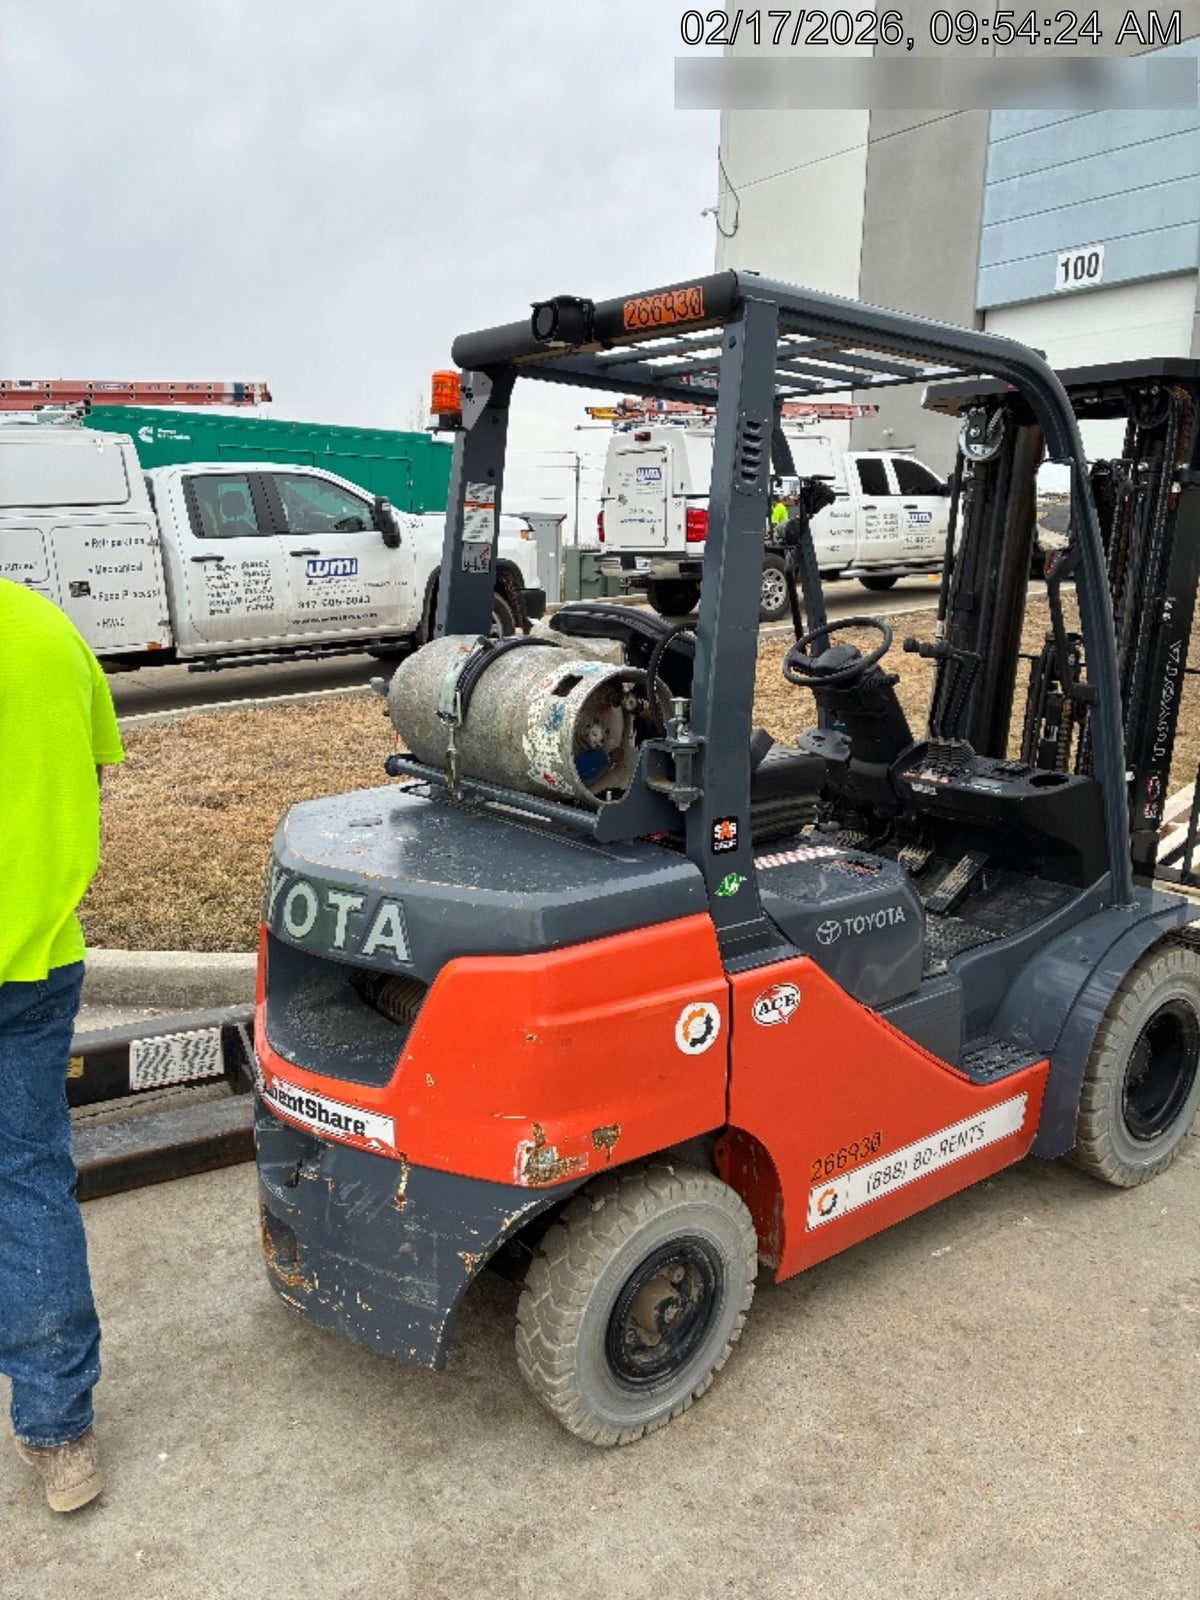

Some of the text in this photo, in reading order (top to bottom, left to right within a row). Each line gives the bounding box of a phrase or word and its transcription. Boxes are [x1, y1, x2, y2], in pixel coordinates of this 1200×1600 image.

[1061, 252, 1100, 283] 100
[844, 906, 906, 936] TOYOTA
[758, 993, 796, 1016] ACE
[811, 1129, 882, 1182] 266930
[866, 1159, 908, 1195] (888)
